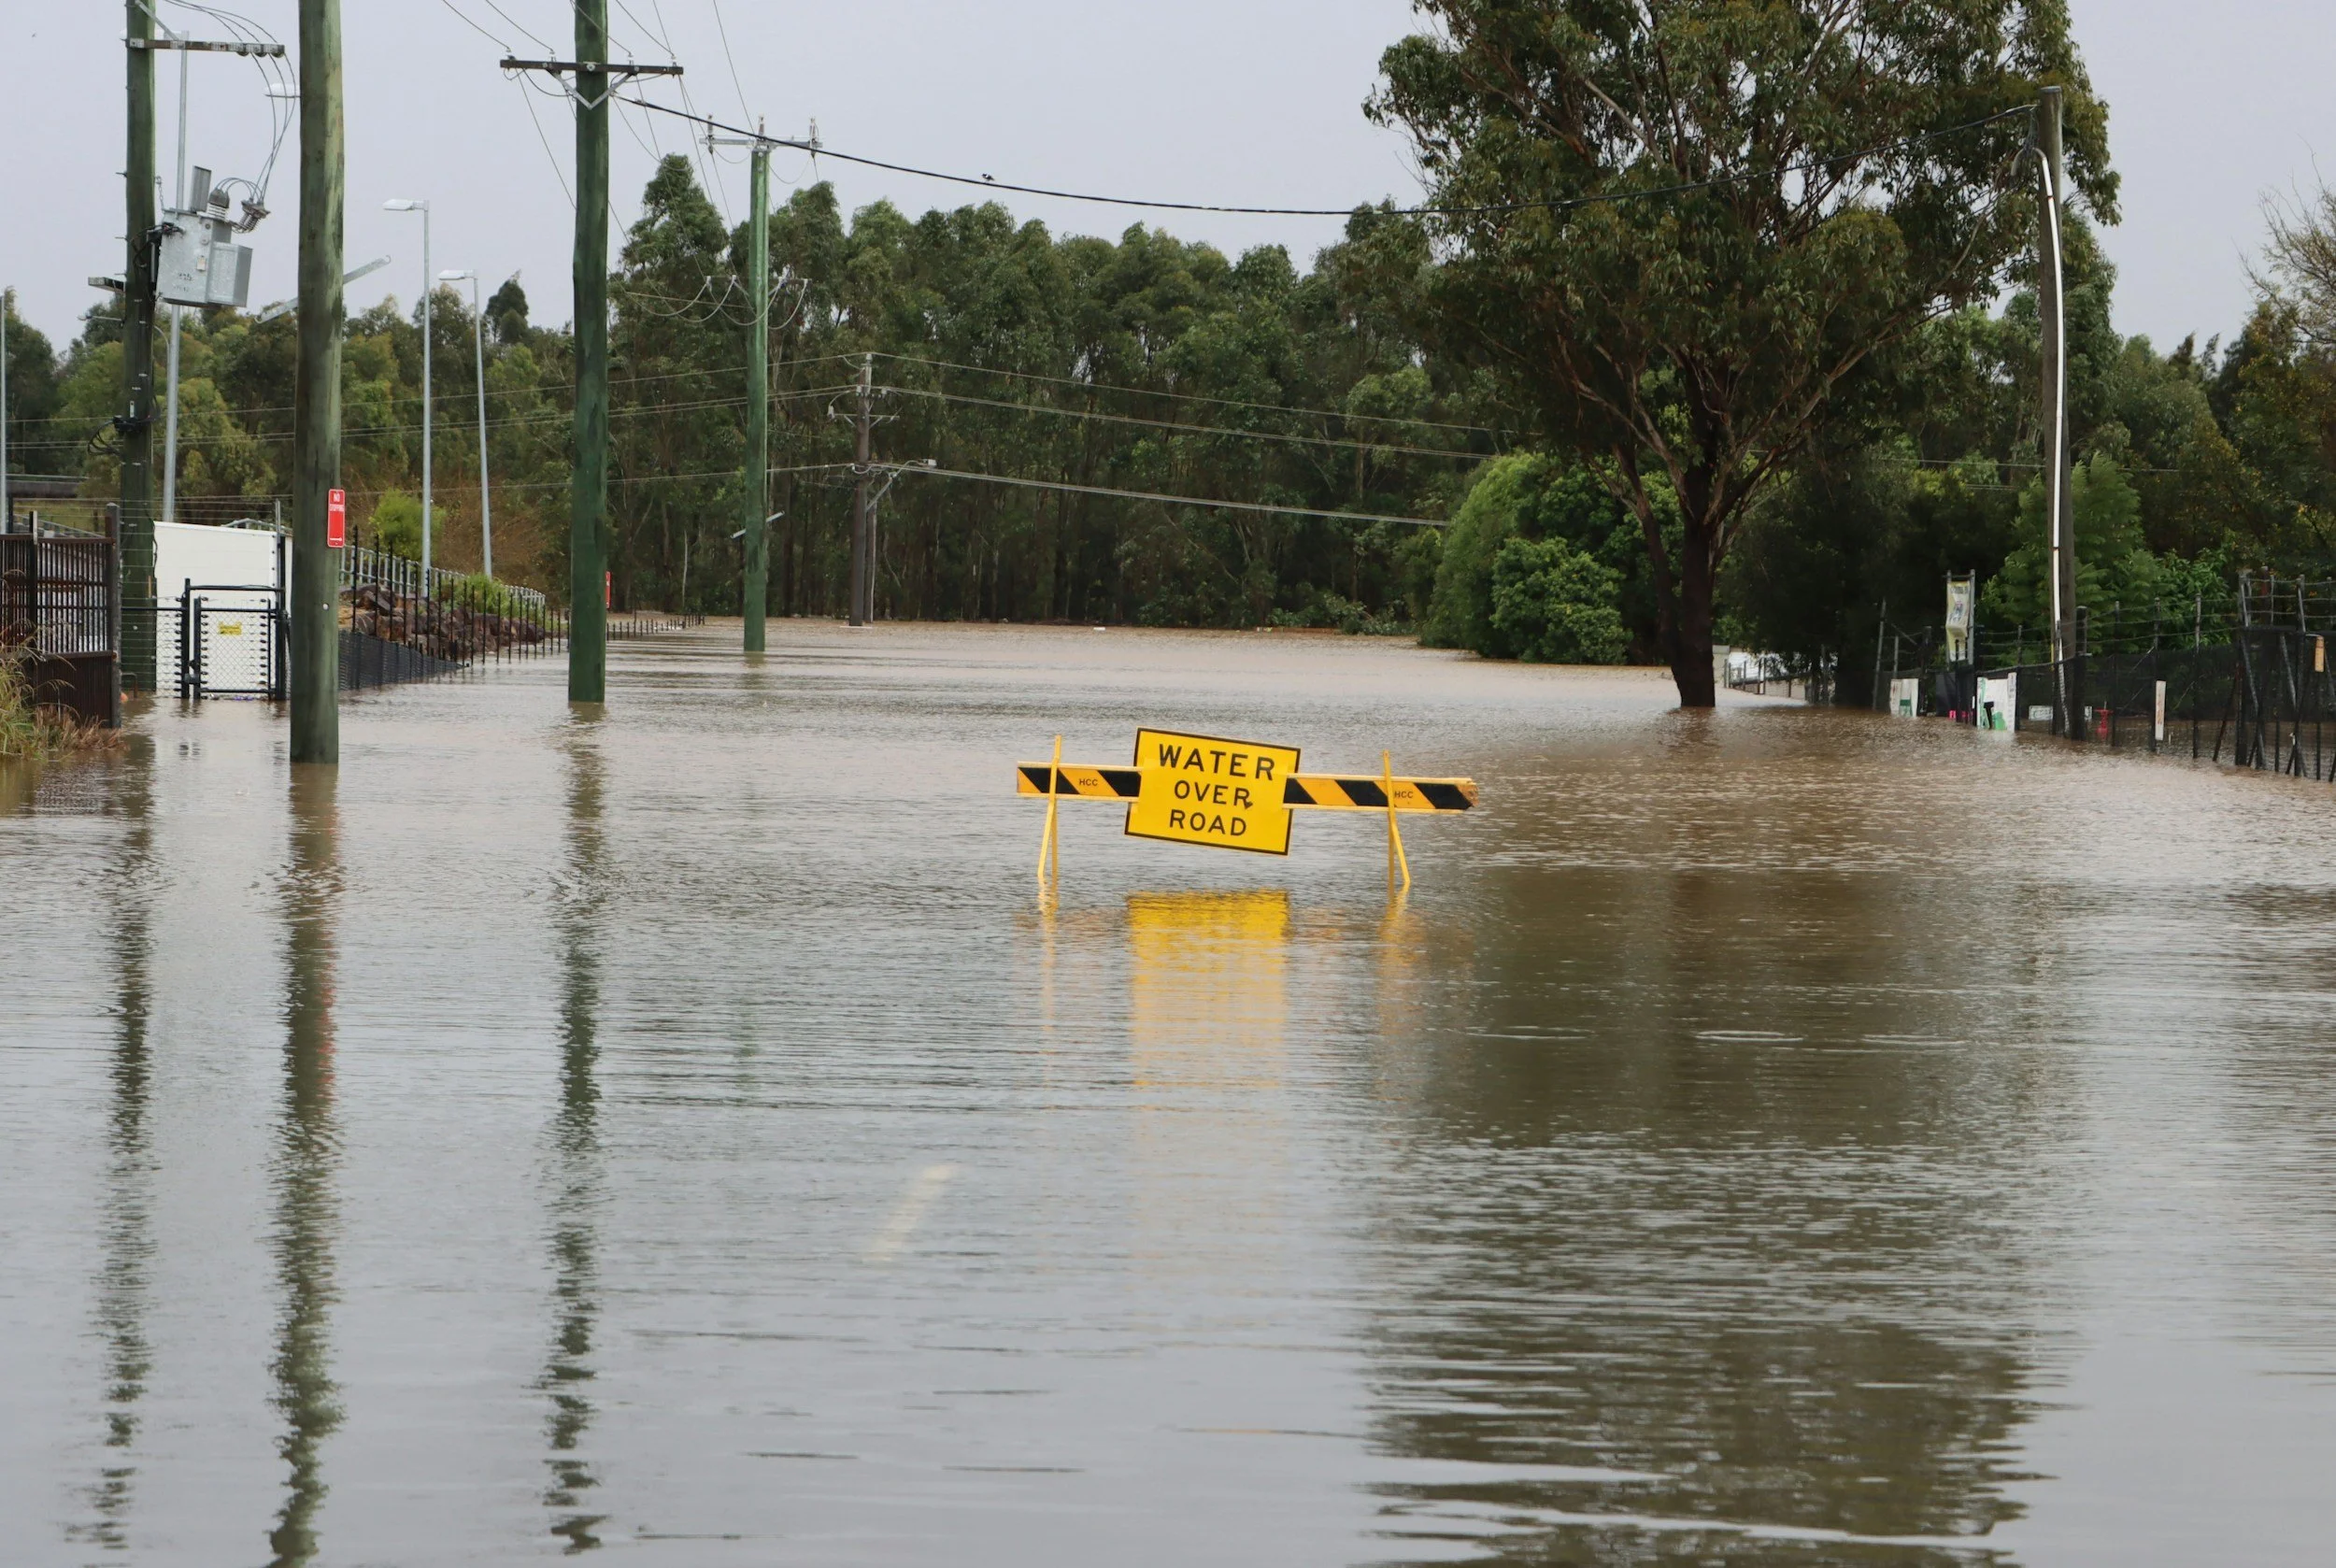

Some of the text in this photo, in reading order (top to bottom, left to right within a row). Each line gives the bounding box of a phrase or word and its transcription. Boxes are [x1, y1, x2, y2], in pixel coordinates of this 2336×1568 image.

[1159, 743, 1275, 781] WATER
[1175, 779, 1252, 808] OVER
[1394, 791, 1414, 799] HCC
[1170, 809, 1246, 836] ROAD
